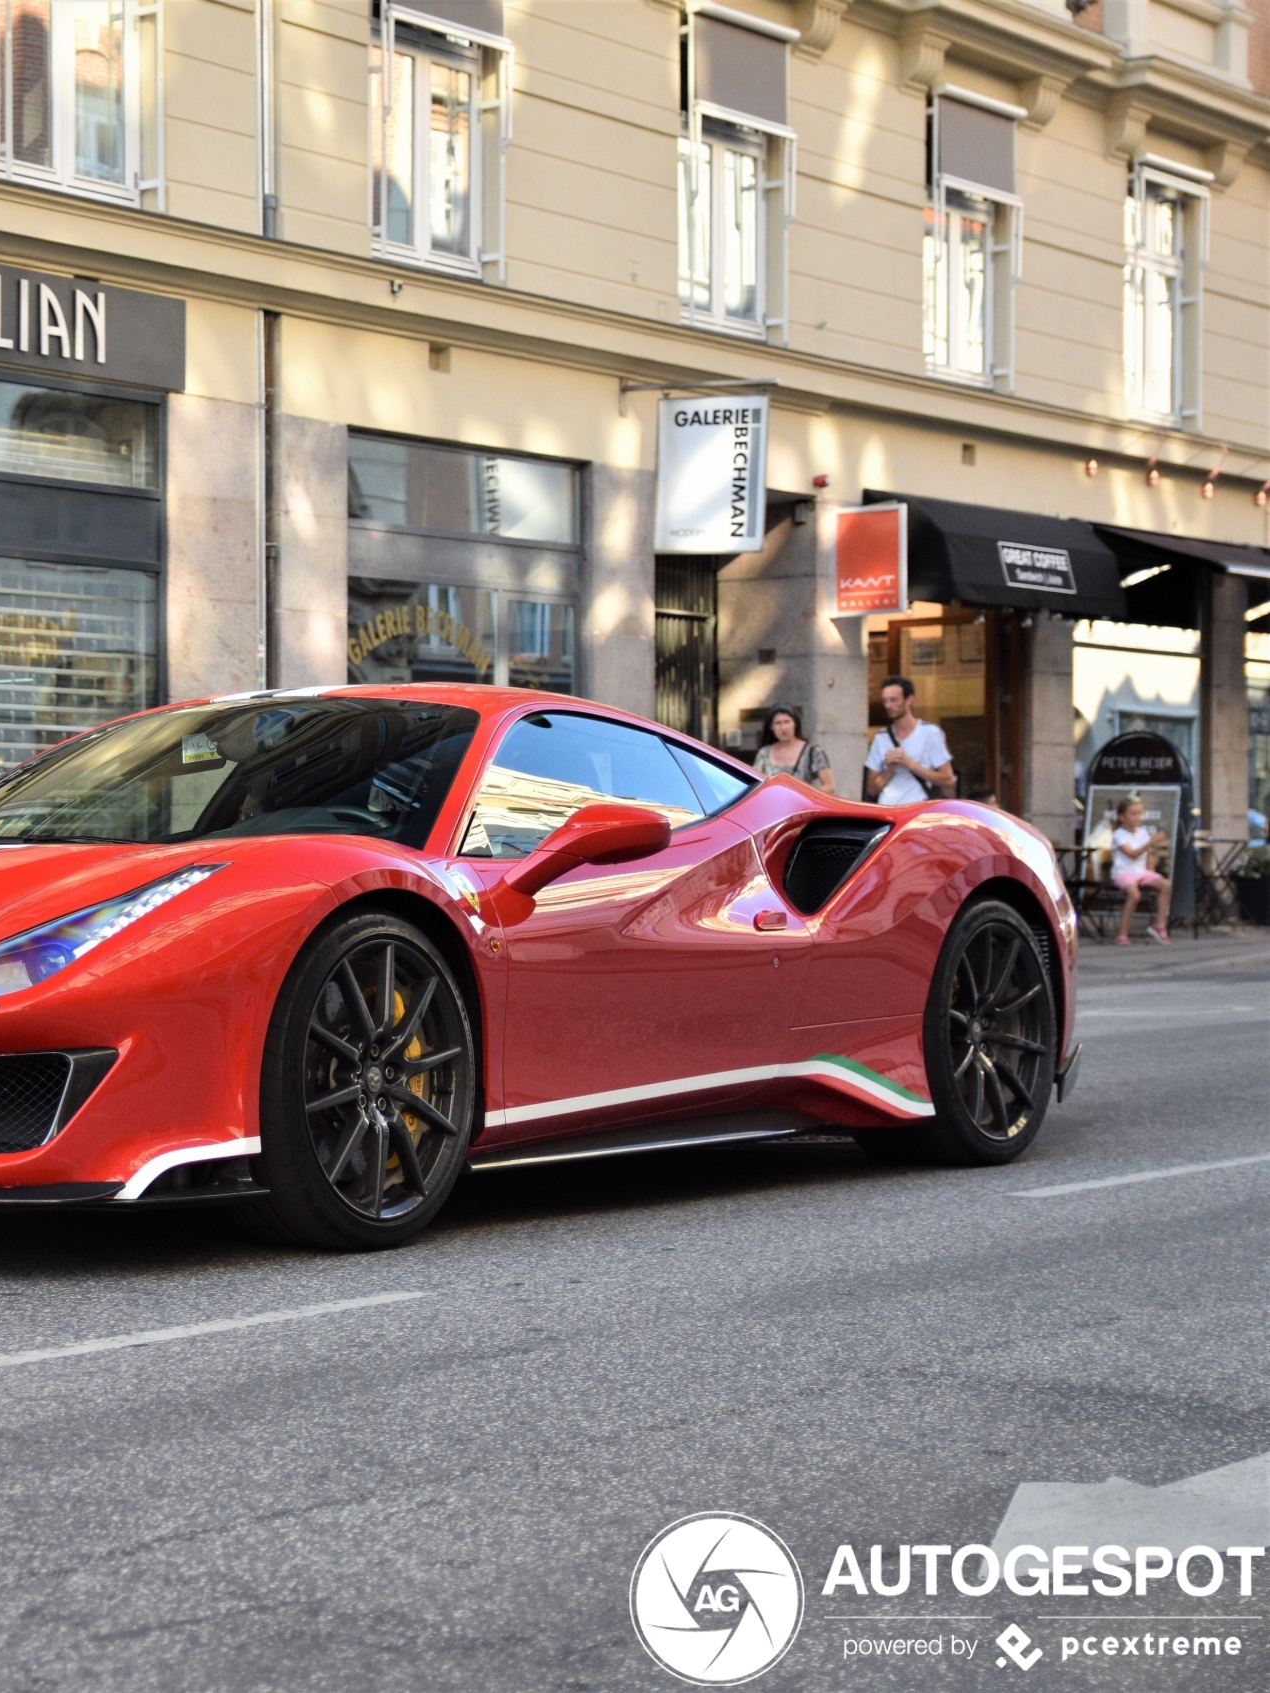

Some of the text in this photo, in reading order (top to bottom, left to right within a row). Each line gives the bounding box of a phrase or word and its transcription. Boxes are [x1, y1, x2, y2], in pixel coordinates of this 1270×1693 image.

[674, 408, 750, 427] GALERIE
[730, 427, 749, 538] BECHMAN
[1002, 547, 1069, 572] GREAT COFFEE
[840, 574, 896, 590] KANT
[347, 604, 492, 676] GALERIE BECHMAN
